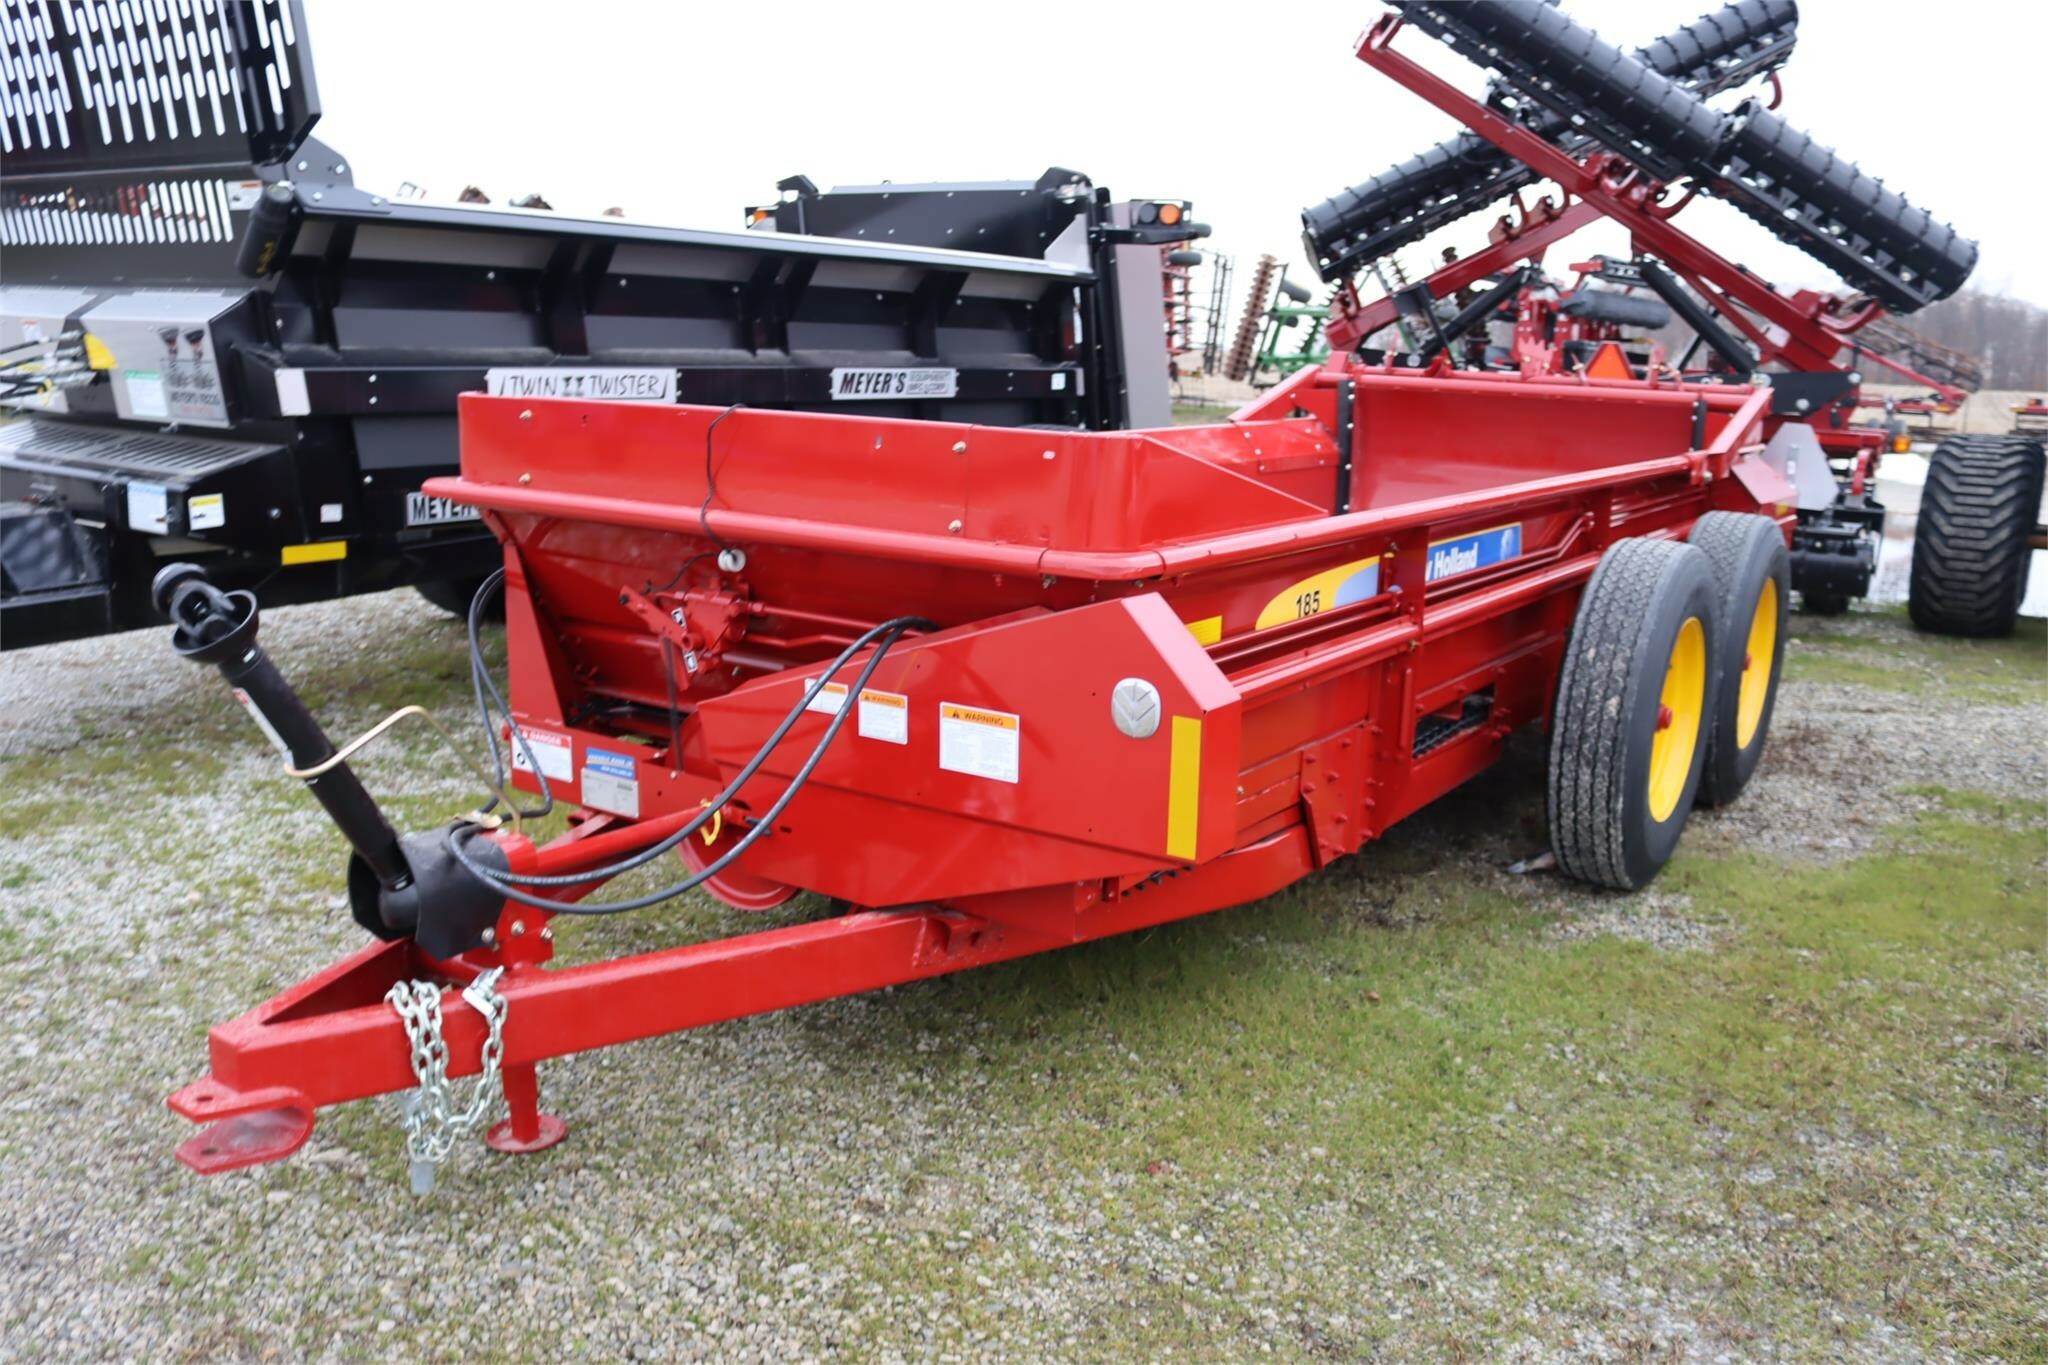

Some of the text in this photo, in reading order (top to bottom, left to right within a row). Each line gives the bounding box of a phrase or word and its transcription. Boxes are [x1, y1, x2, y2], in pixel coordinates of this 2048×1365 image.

[509, 375, 558, 396] TWIN
[589, 374, 660, 396] TWISTER
[839, 371, 907, 394] MEYER'S
[1434, 541, 1479, 580] Holland
[1296, 590, 1320, 618] 185
[964, 711, 1004, 727] WARNING
